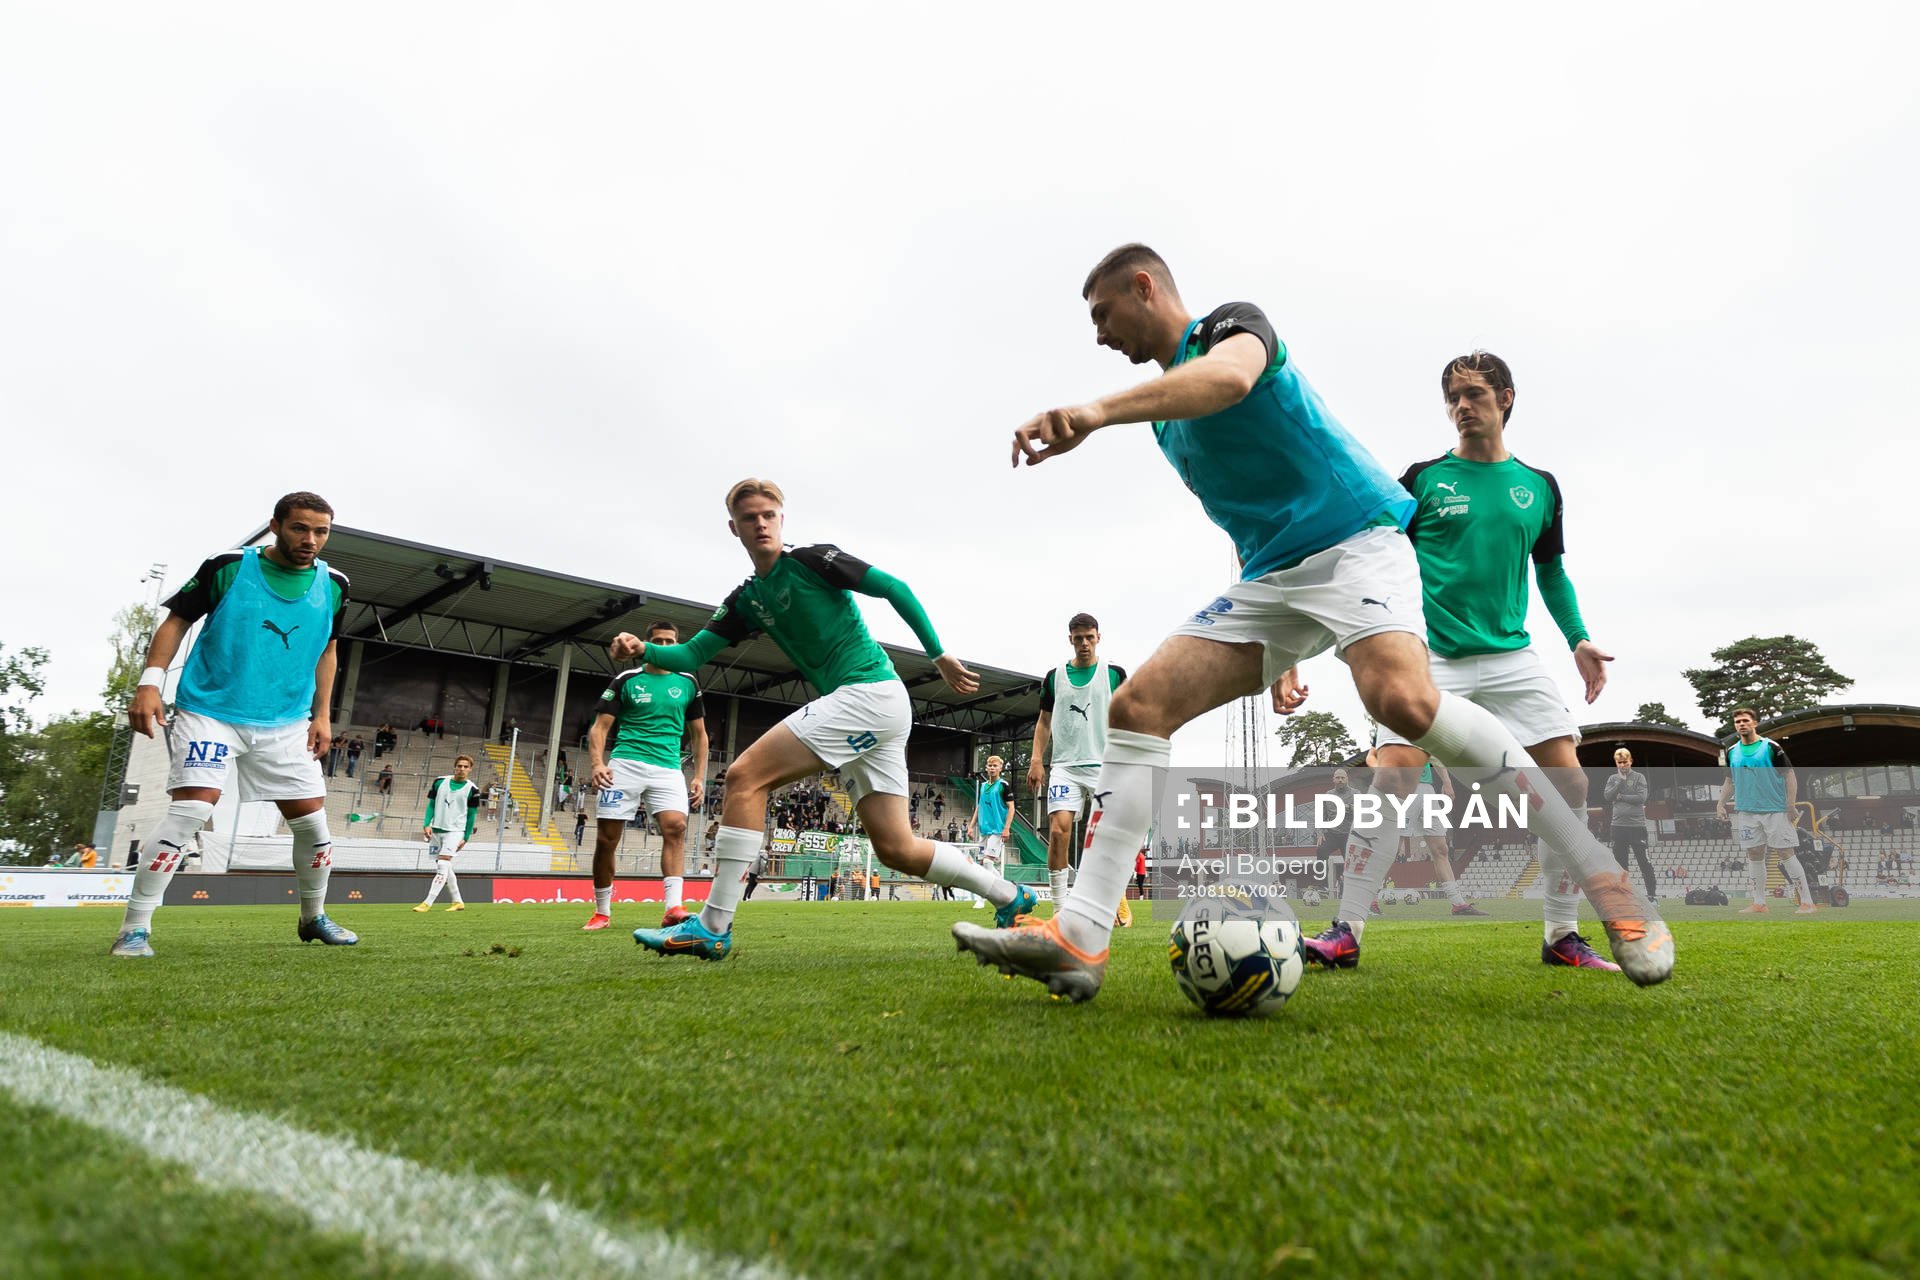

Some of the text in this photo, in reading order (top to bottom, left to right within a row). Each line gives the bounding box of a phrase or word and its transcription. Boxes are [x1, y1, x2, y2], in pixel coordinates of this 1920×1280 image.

[185, 741, 229, 762] NP
[772, 842, 795, 852] CREW
[1193, 908, 1218, 979] SELECT
